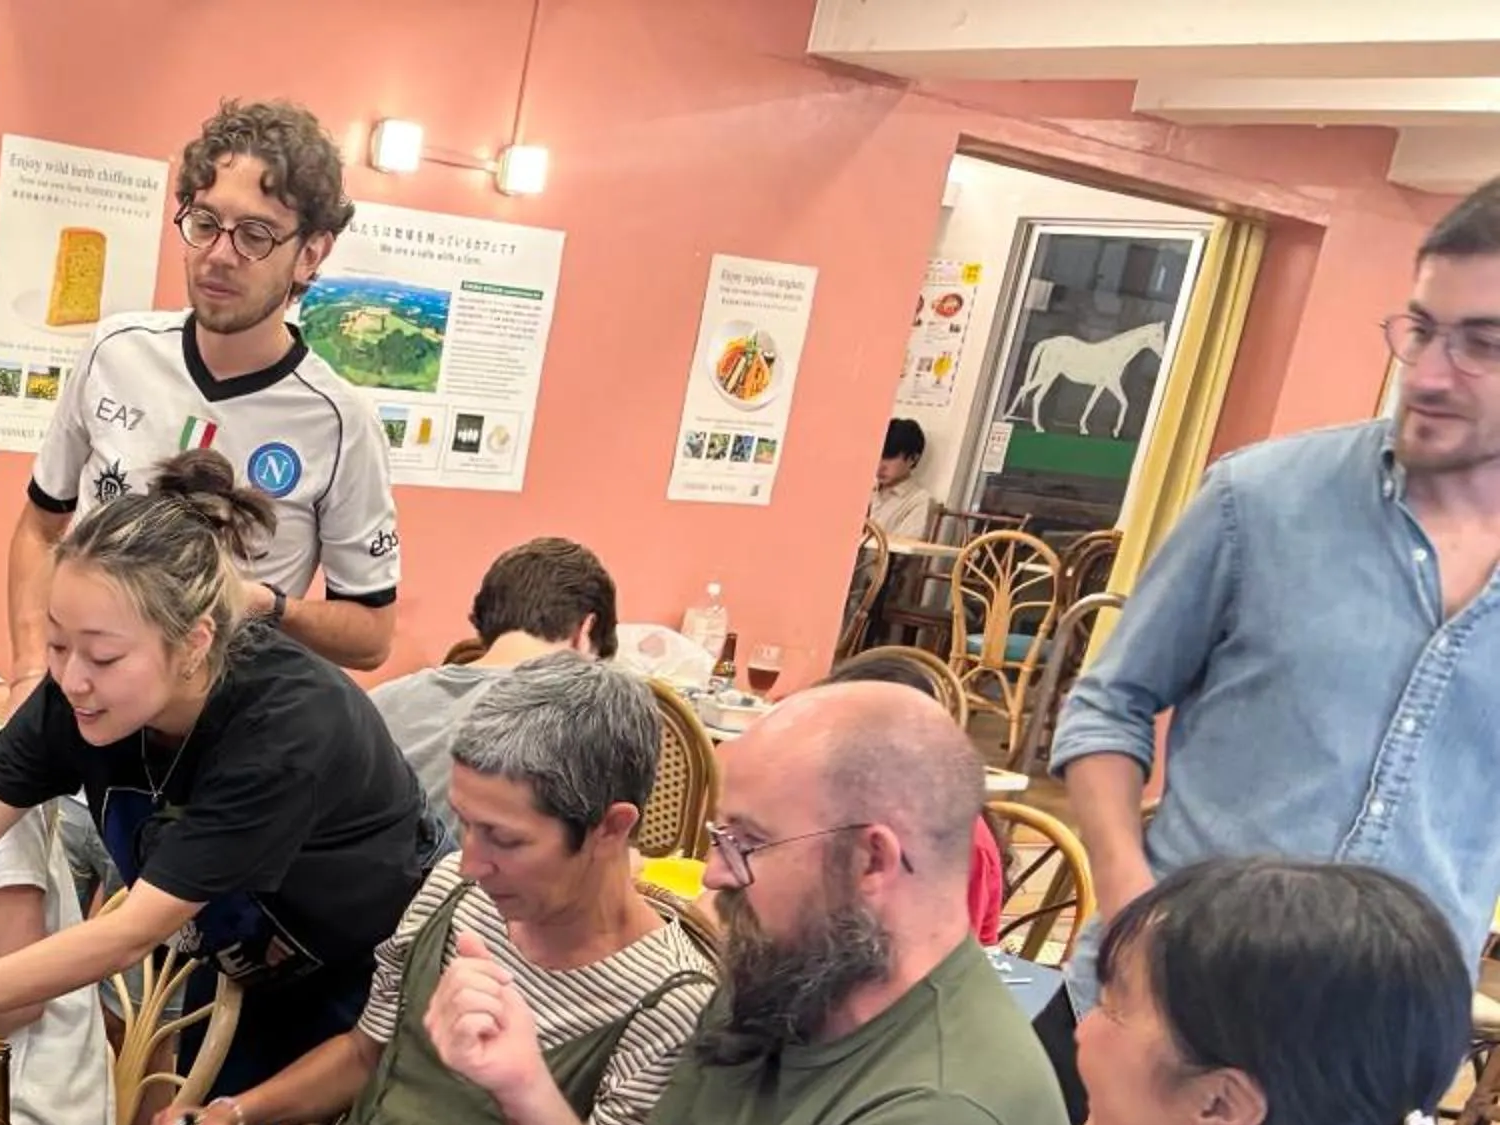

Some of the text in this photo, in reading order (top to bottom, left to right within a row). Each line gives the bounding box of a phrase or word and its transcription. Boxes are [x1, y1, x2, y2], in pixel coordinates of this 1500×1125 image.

[9, 152, 42, 173] Enjoy
[44, 160, 69, 176] wild
[135, 175, 159, 191] cake
[95, 397, 146, 431] EA7
[260, 457, 289, 486] N
